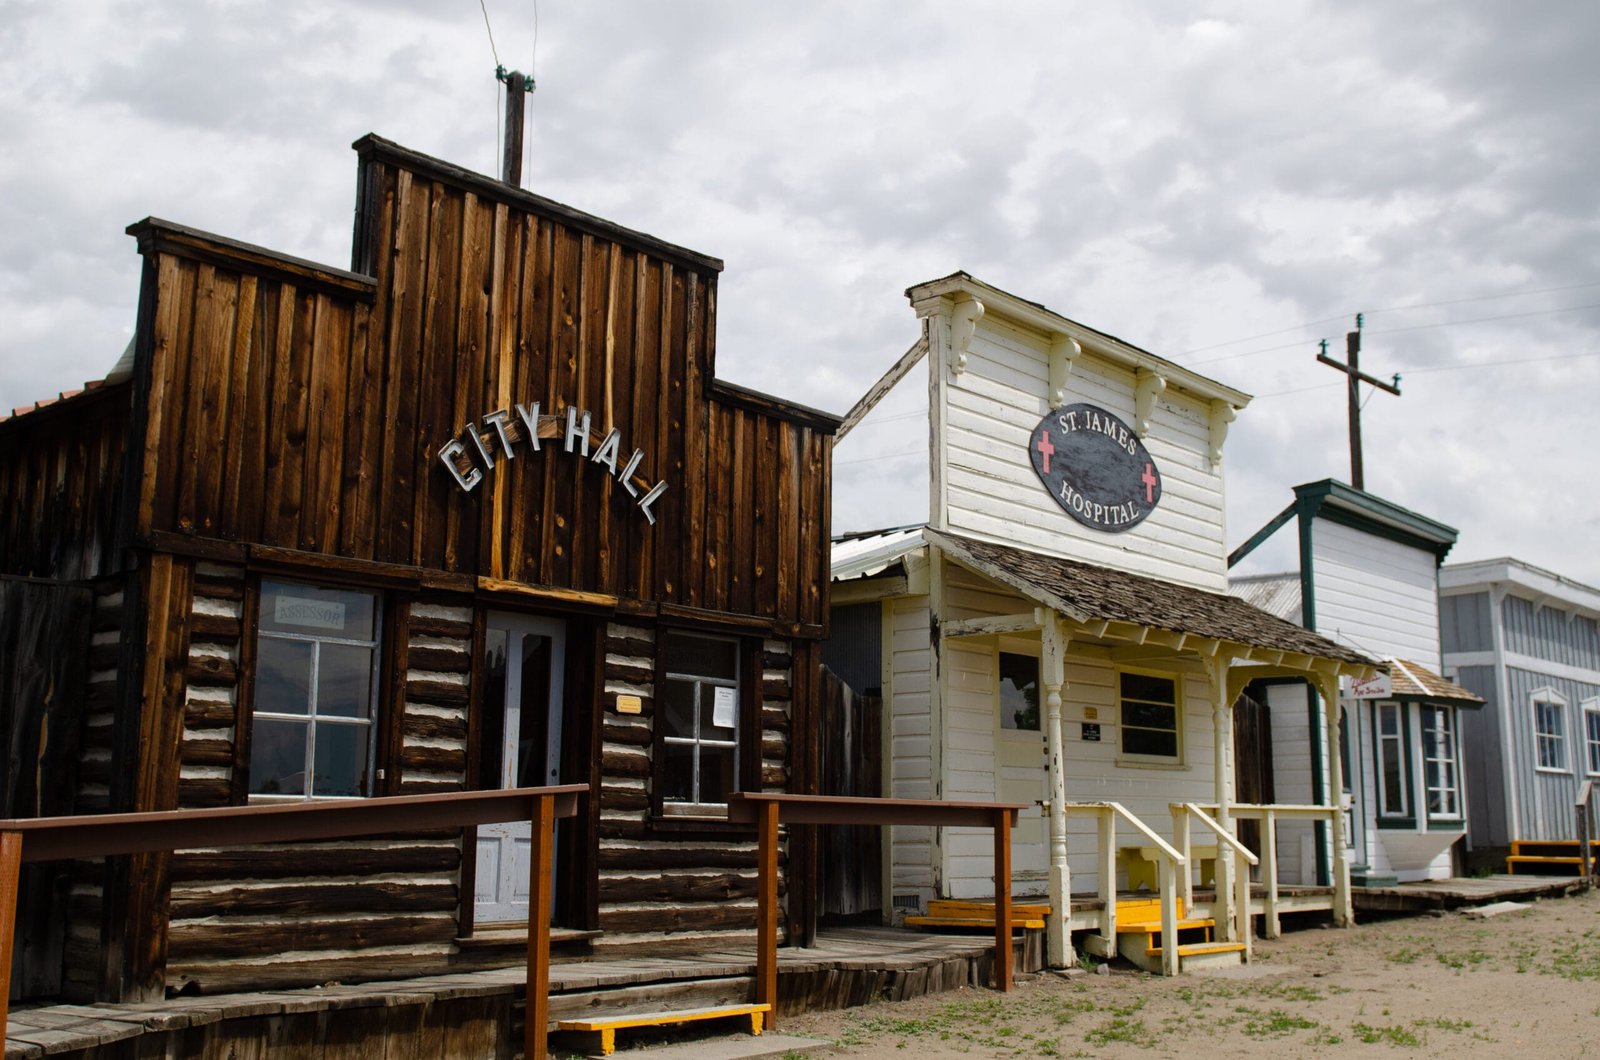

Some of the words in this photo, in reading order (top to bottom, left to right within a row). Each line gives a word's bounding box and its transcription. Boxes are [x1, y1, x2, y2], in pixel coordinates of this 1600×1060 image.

[1059, 411, 1081, 434] ST.
[1085, 411, 1137, 456] JAMES
[438, 401, 541, 492] CITY
[564, 405, 669, 525] HALL
[1059, 480, 1139, 525] HOSPITAL
[280, 604, 340, 625] ASSESSOR
